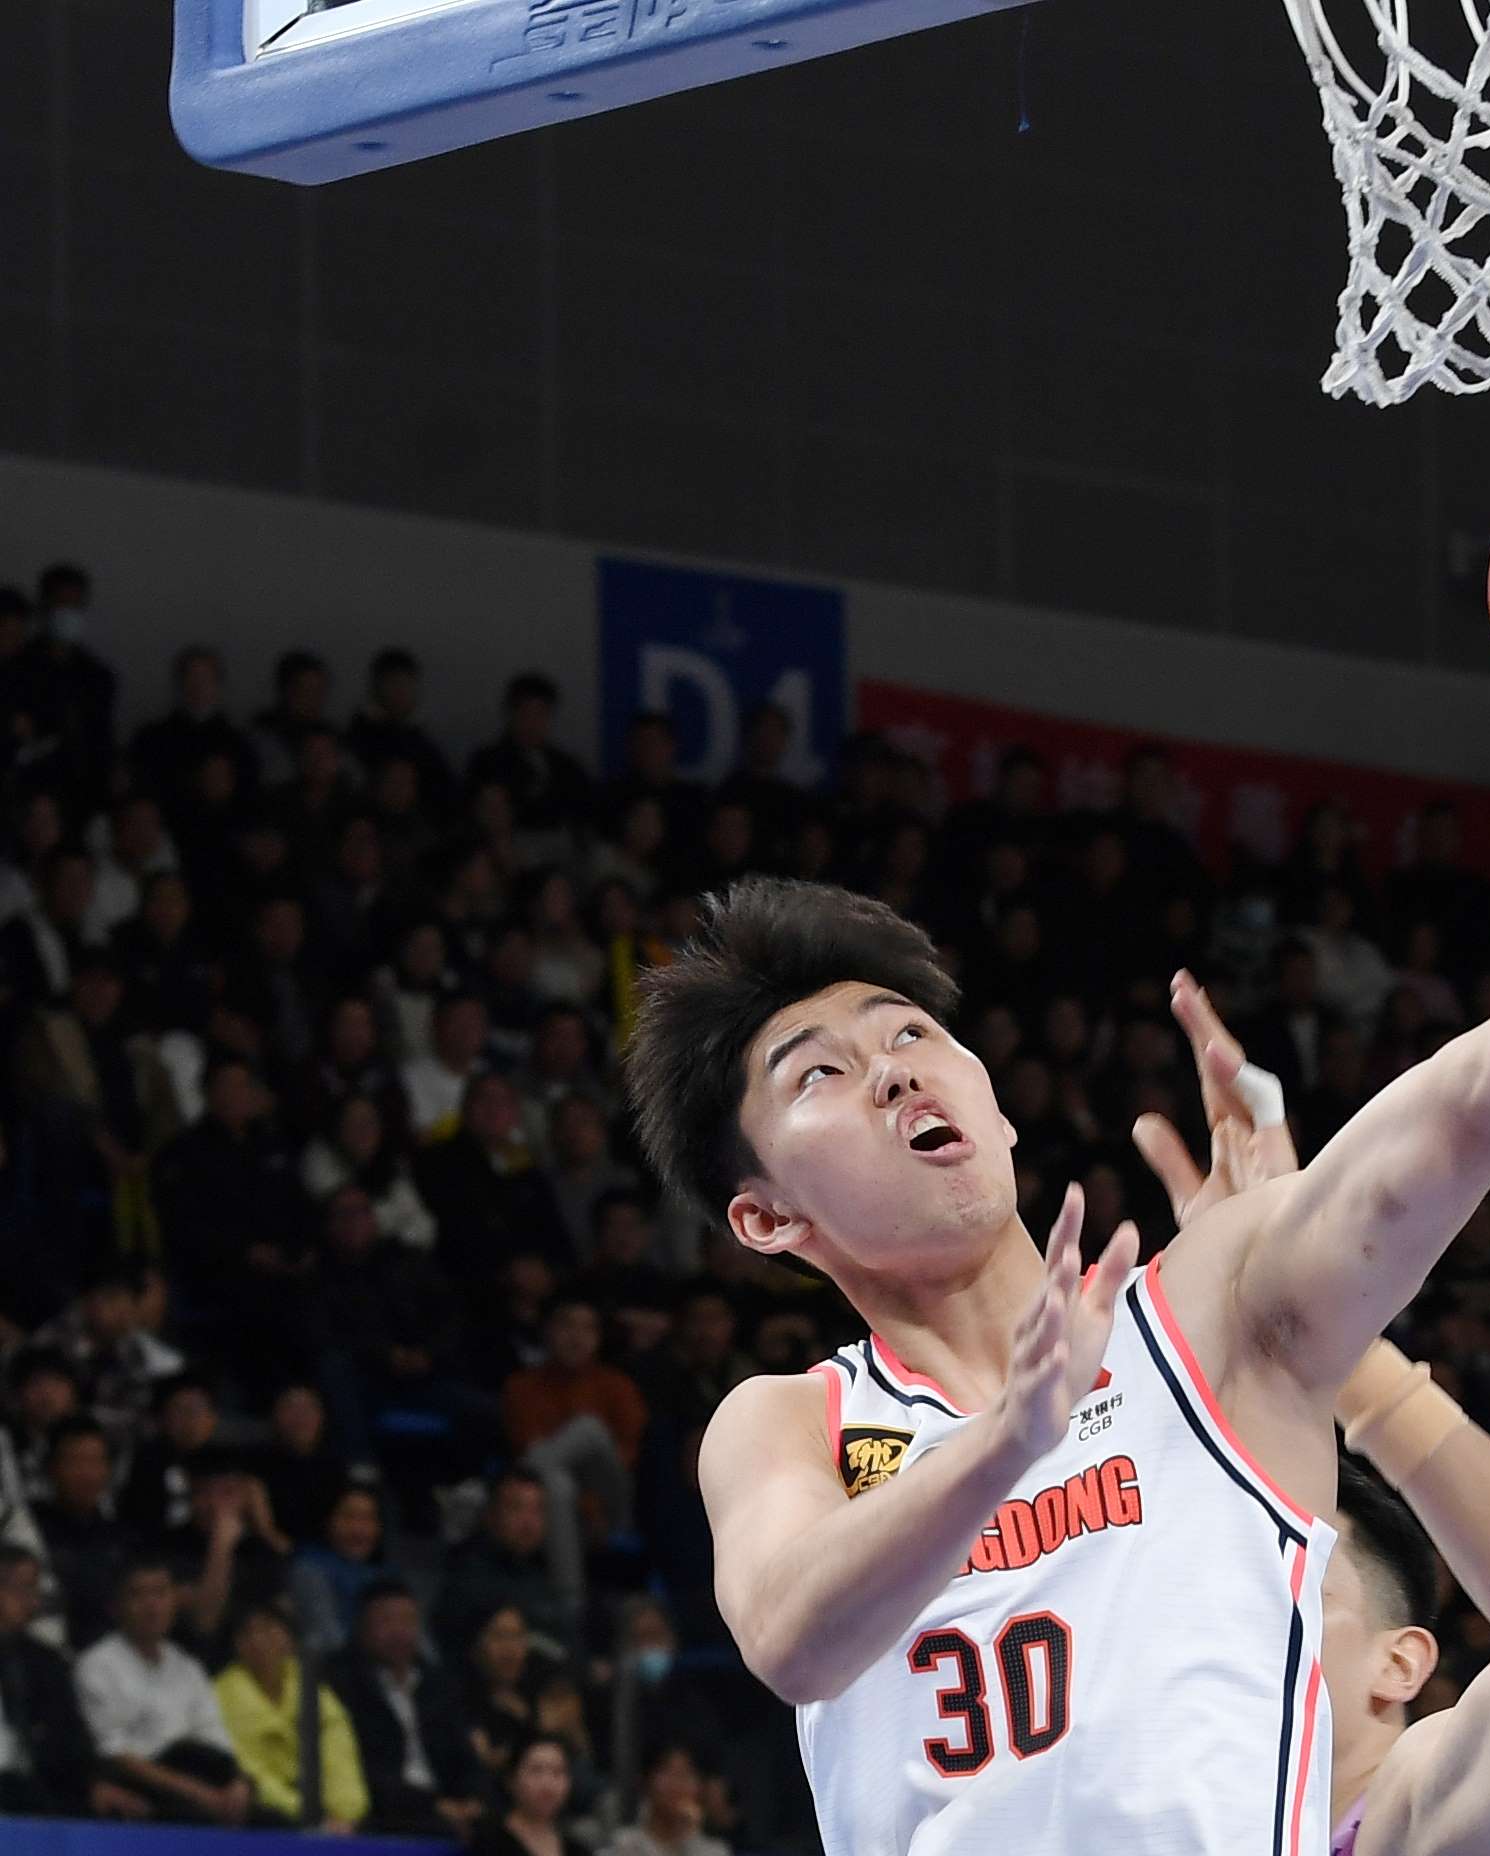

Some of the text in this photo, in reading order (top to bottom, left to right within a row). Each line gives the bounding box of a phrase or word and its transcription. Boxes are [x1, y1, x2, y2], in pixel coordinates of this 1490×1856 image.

[1070, 1392, 1123, 1424] 发银行
[1078, 1415, 1113, 1442] CGB
[953, 1453, 1143, 1578] GDONG
[906, 1609, 1073, 1779] 30
